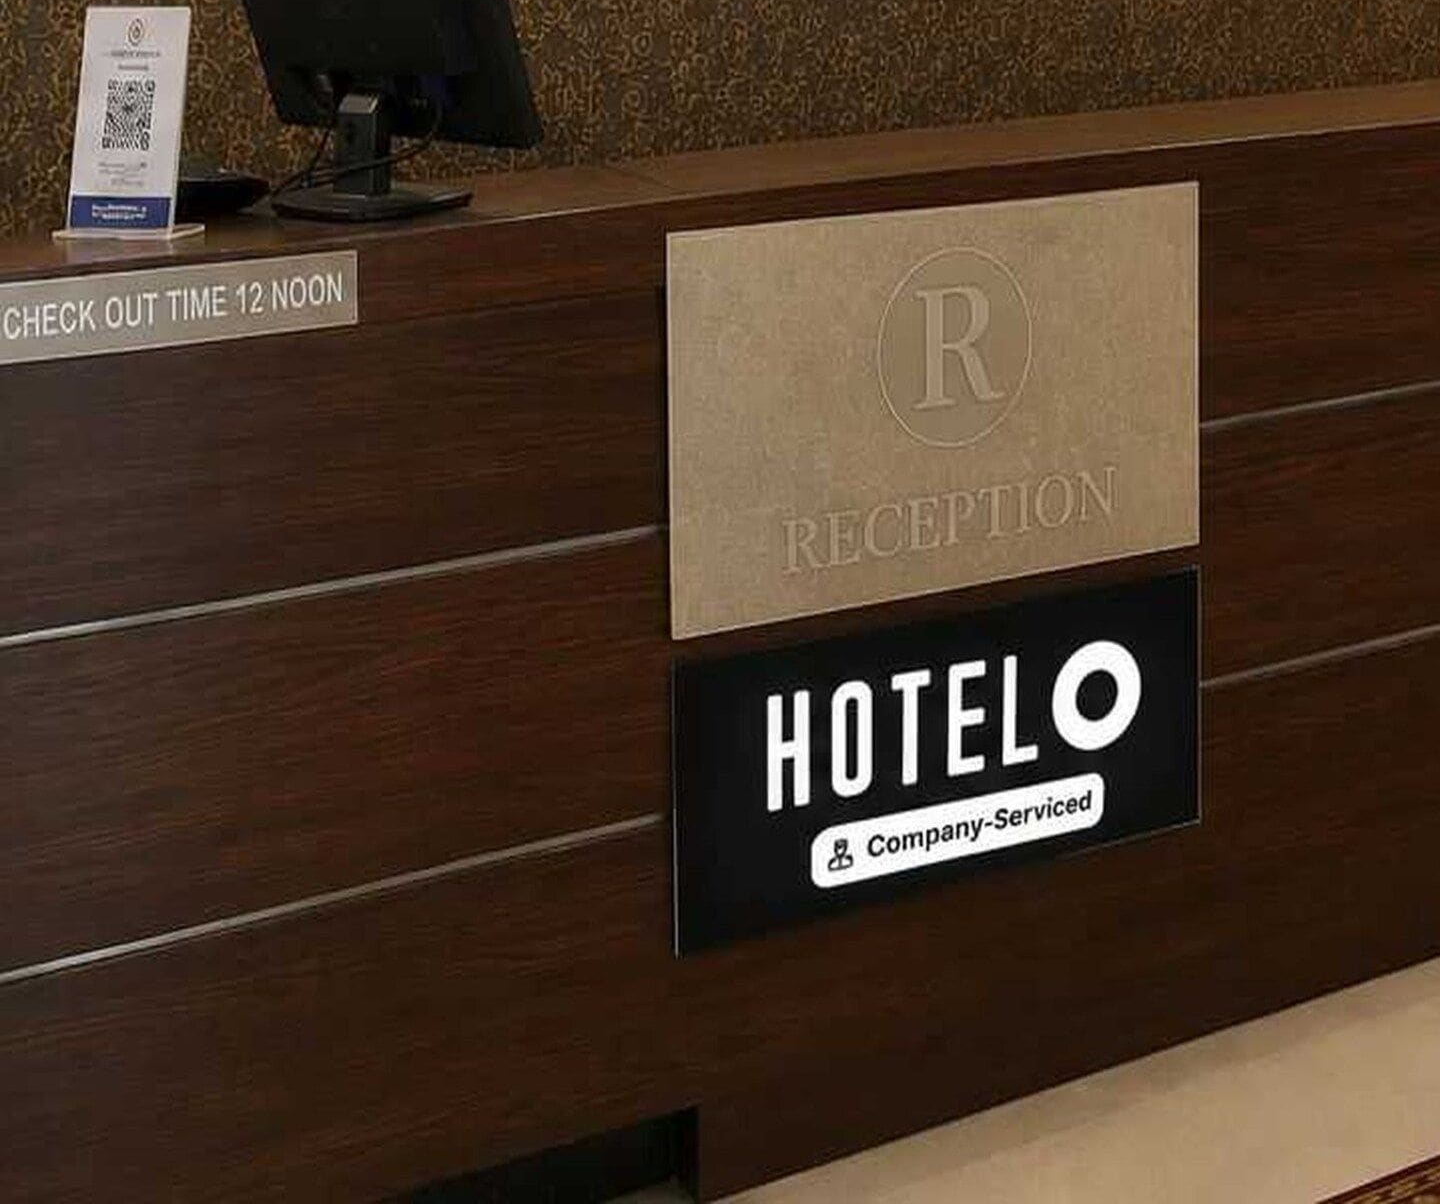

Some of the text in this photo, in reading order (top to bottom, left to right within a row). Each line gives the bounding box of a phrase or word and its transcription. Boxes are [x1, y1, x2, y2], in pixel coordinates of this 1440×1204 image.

[4, 271, 343, 340] CHECK OUT TIME 12 NOON
[914, 282, 1003, 411] R
[782, 465, 1119, 575] RECEPTION
[767, 640, 1142, 813] HOTEL O
[867, 790, 1092, 860] Company-Serviced
